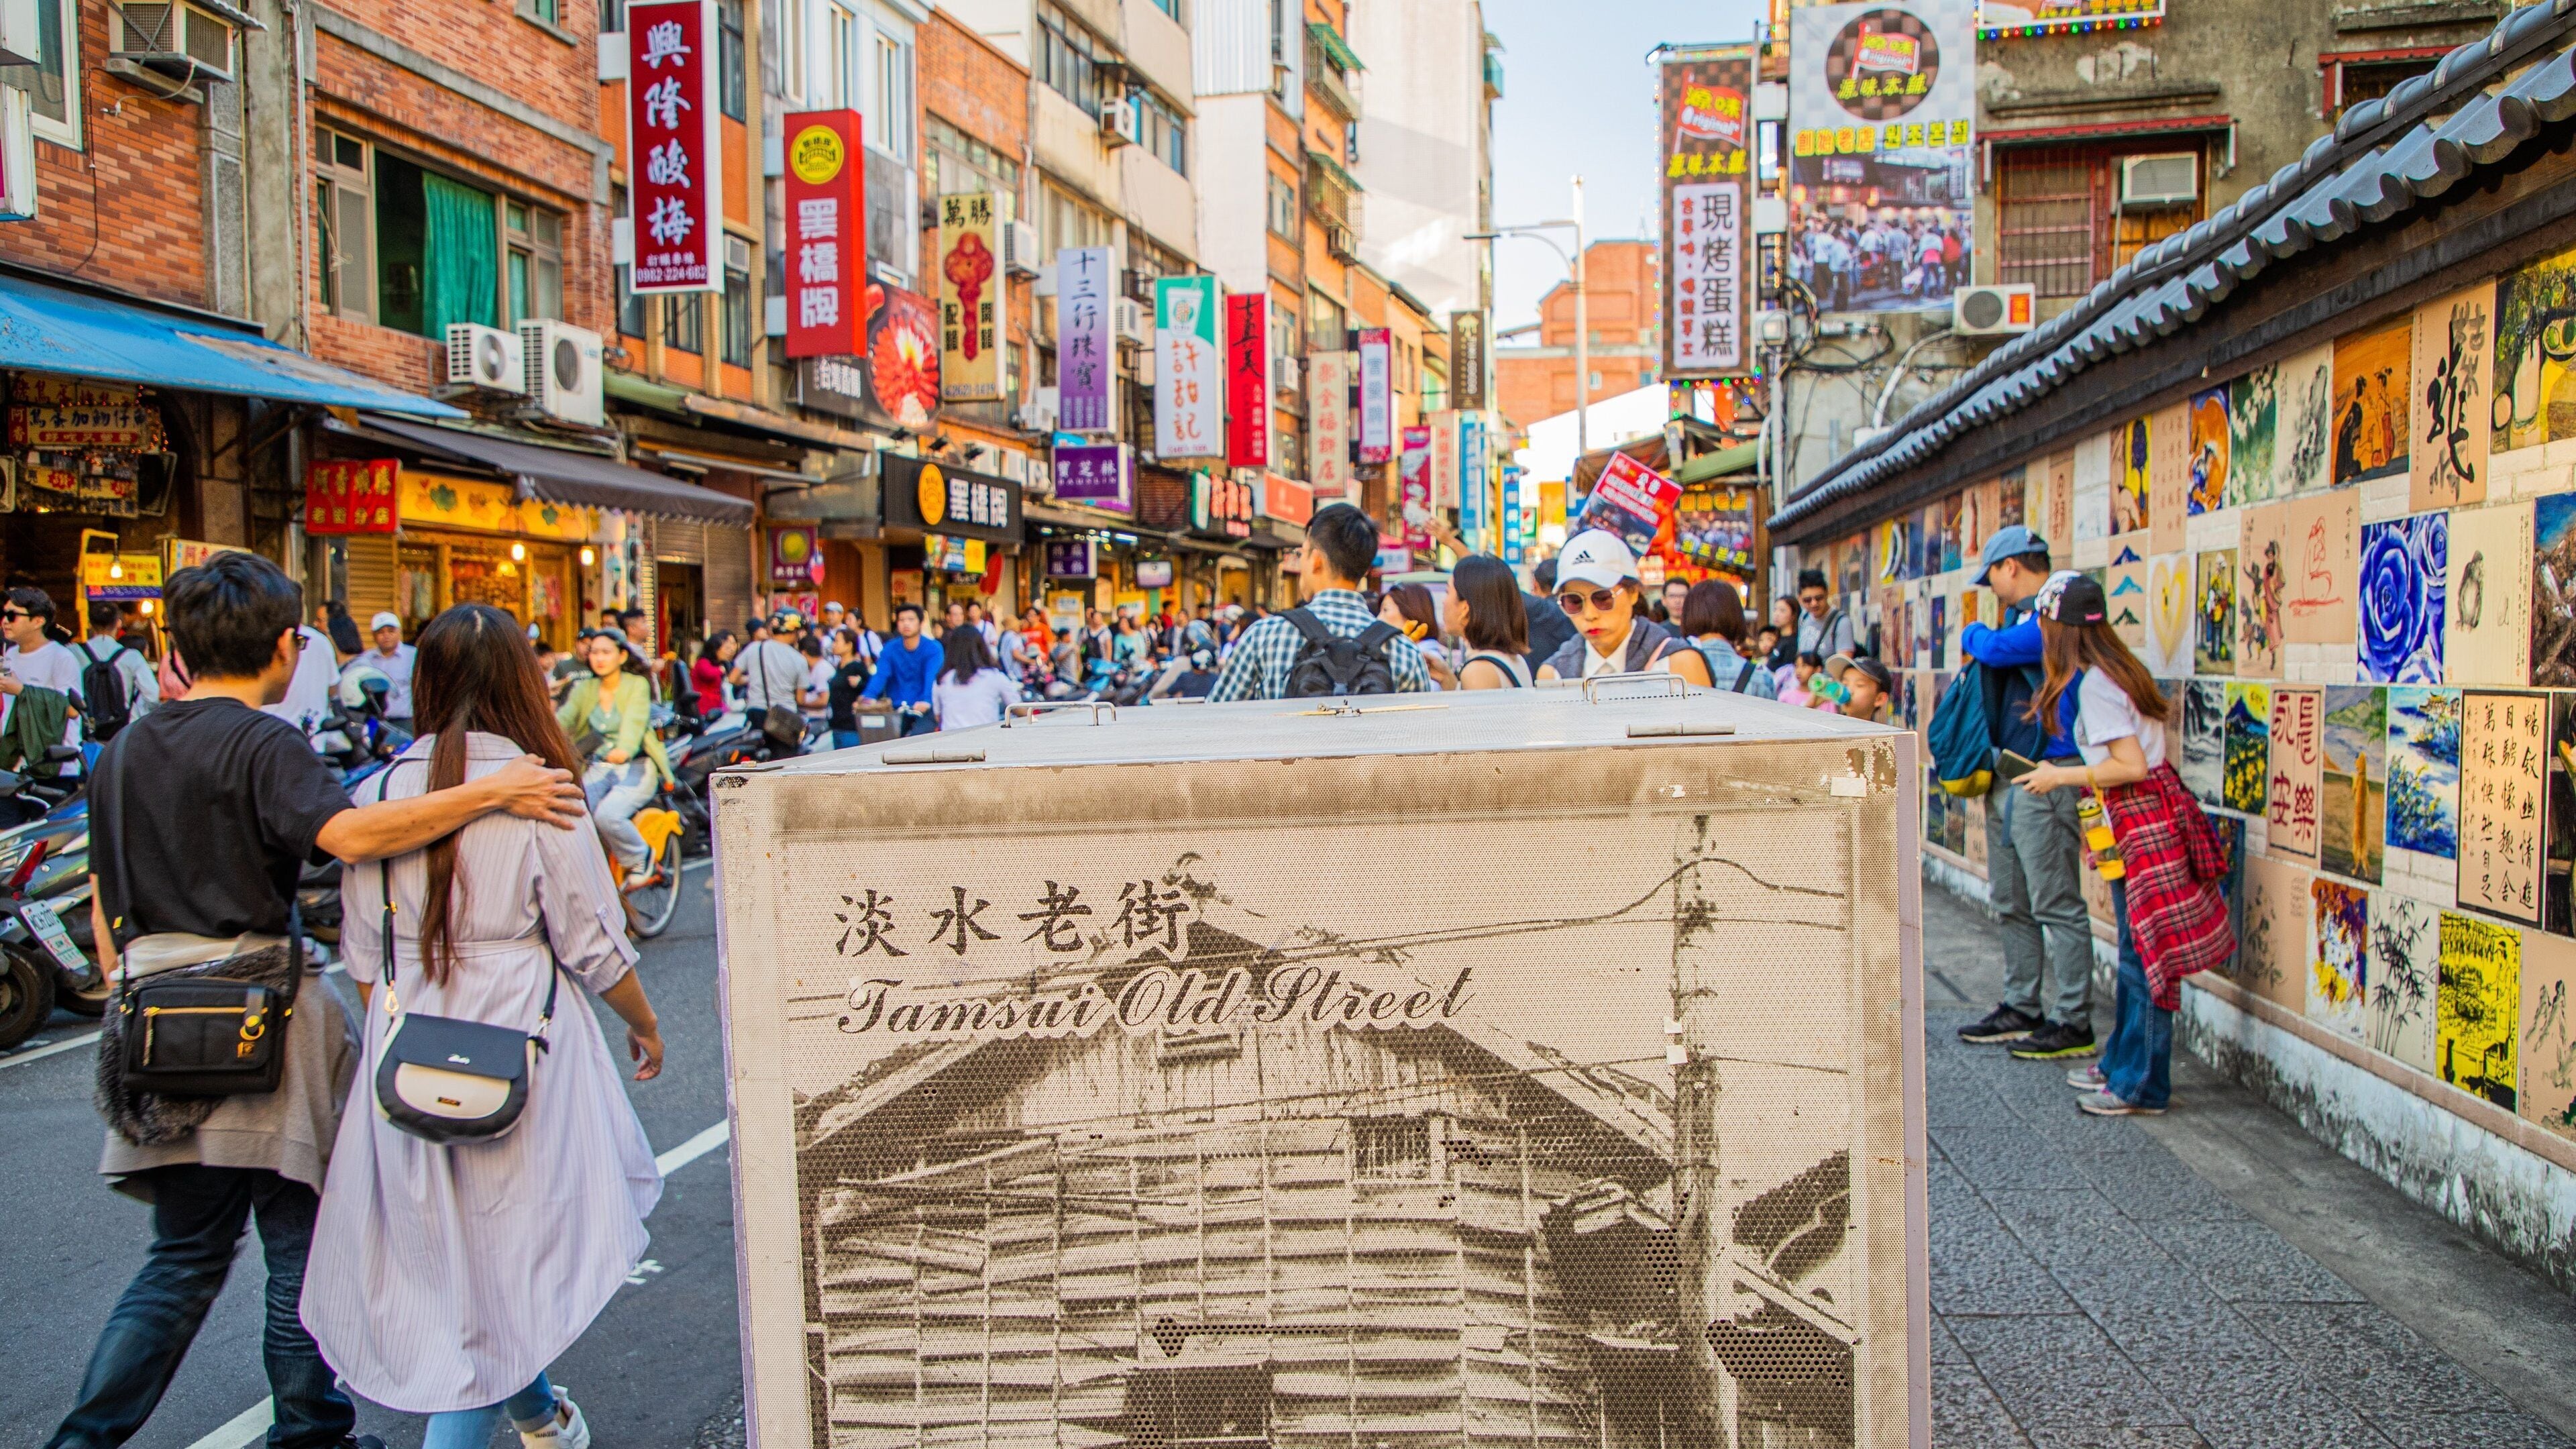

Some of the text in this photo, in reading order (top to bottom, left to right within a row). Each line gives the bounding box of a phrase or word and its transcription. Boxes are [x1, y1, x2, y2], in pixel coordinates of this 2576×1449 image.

[641, 20, 694, 246] 興隆酸梅
[798, 197, 839, 328] 黑橋牌
[1071, 251, 1099, 392] 十三行珠寶
[1701, 193, 1733, 357] 現烤蛋糕
[949, 477, 1008, 528] 黑橋牌
[834, 879, 1190, 961] 淡水老街
[838, 966, 1476, 1034] Tamsui Old Street
